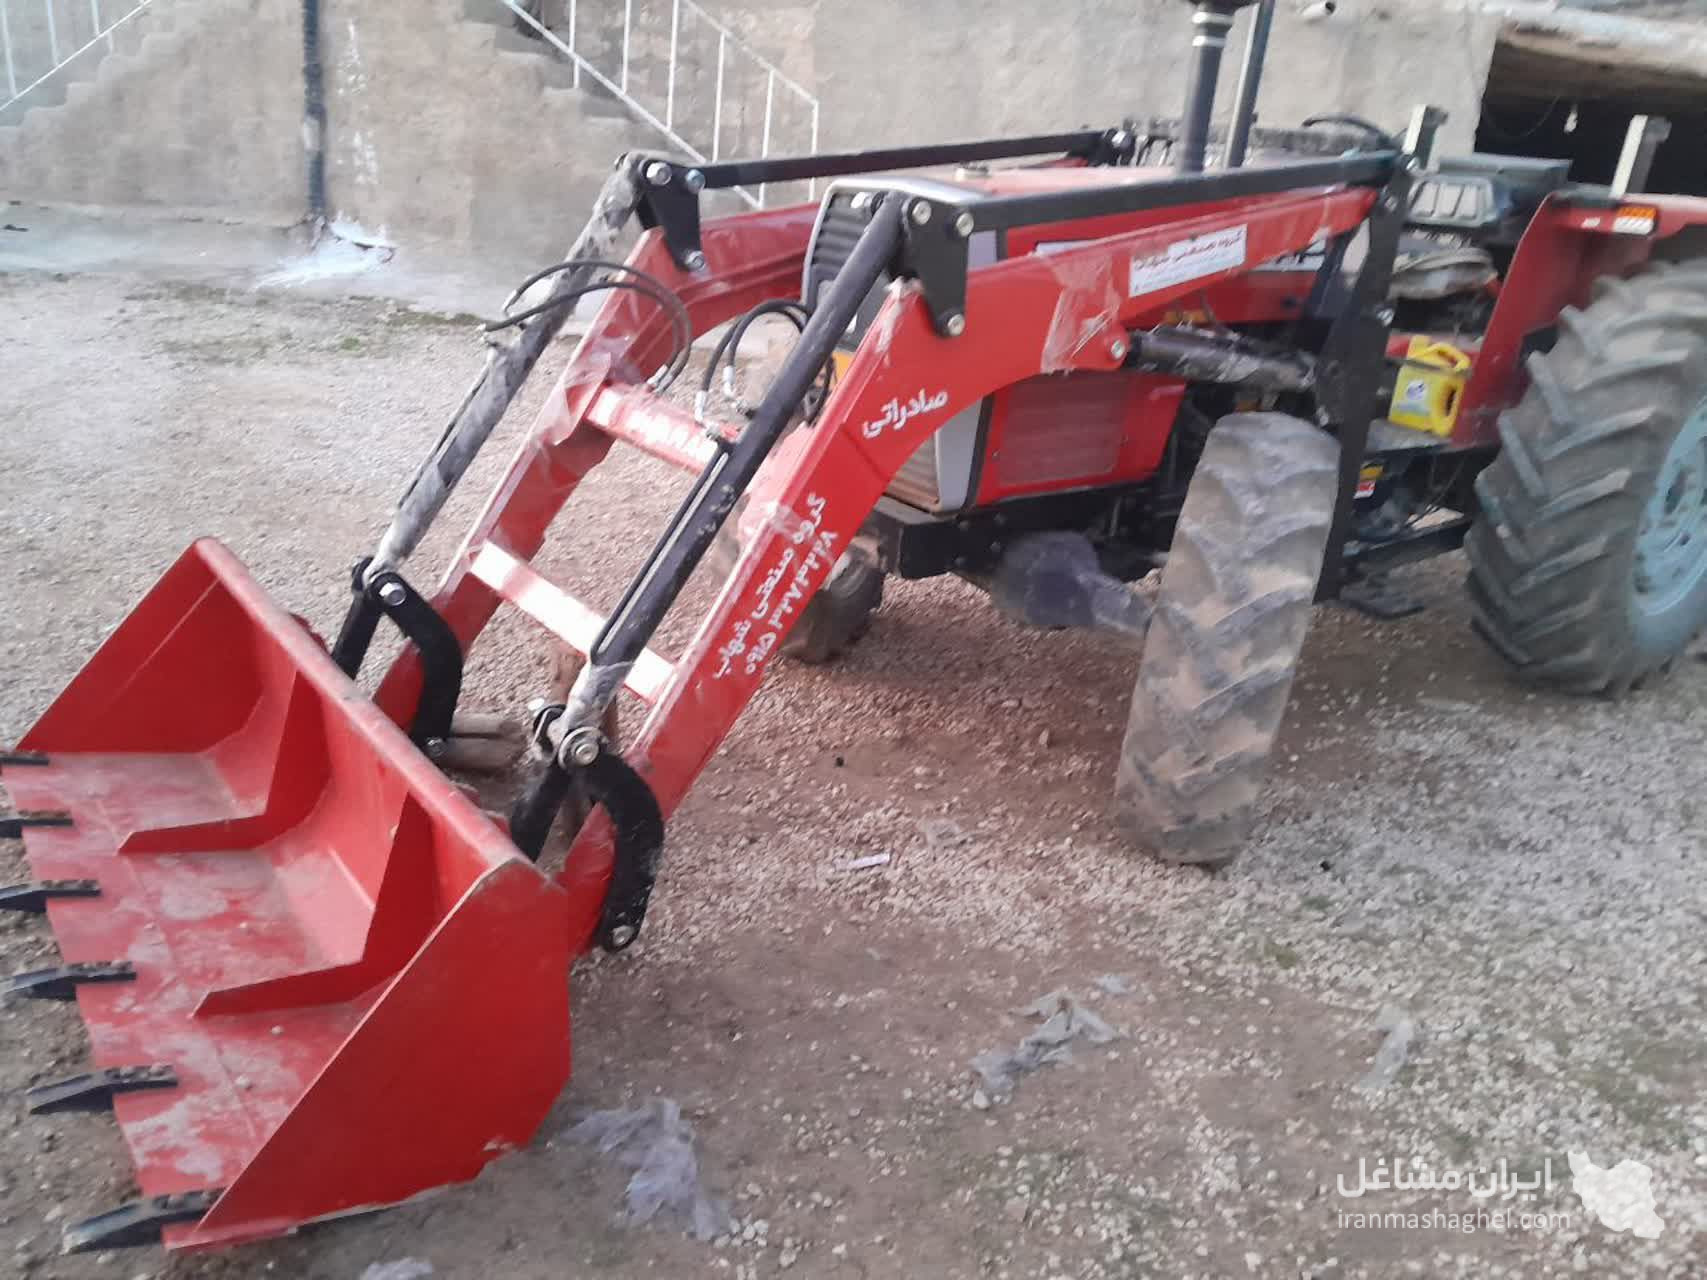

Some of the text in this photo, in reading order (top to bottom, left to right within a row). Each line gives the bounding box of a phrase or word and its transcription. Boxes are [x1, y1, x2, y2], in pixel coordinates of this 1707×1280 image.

[863, 391, 947, 439] صادراتی
[712, 494, 827, 680] گروه صنعتی شهاب
